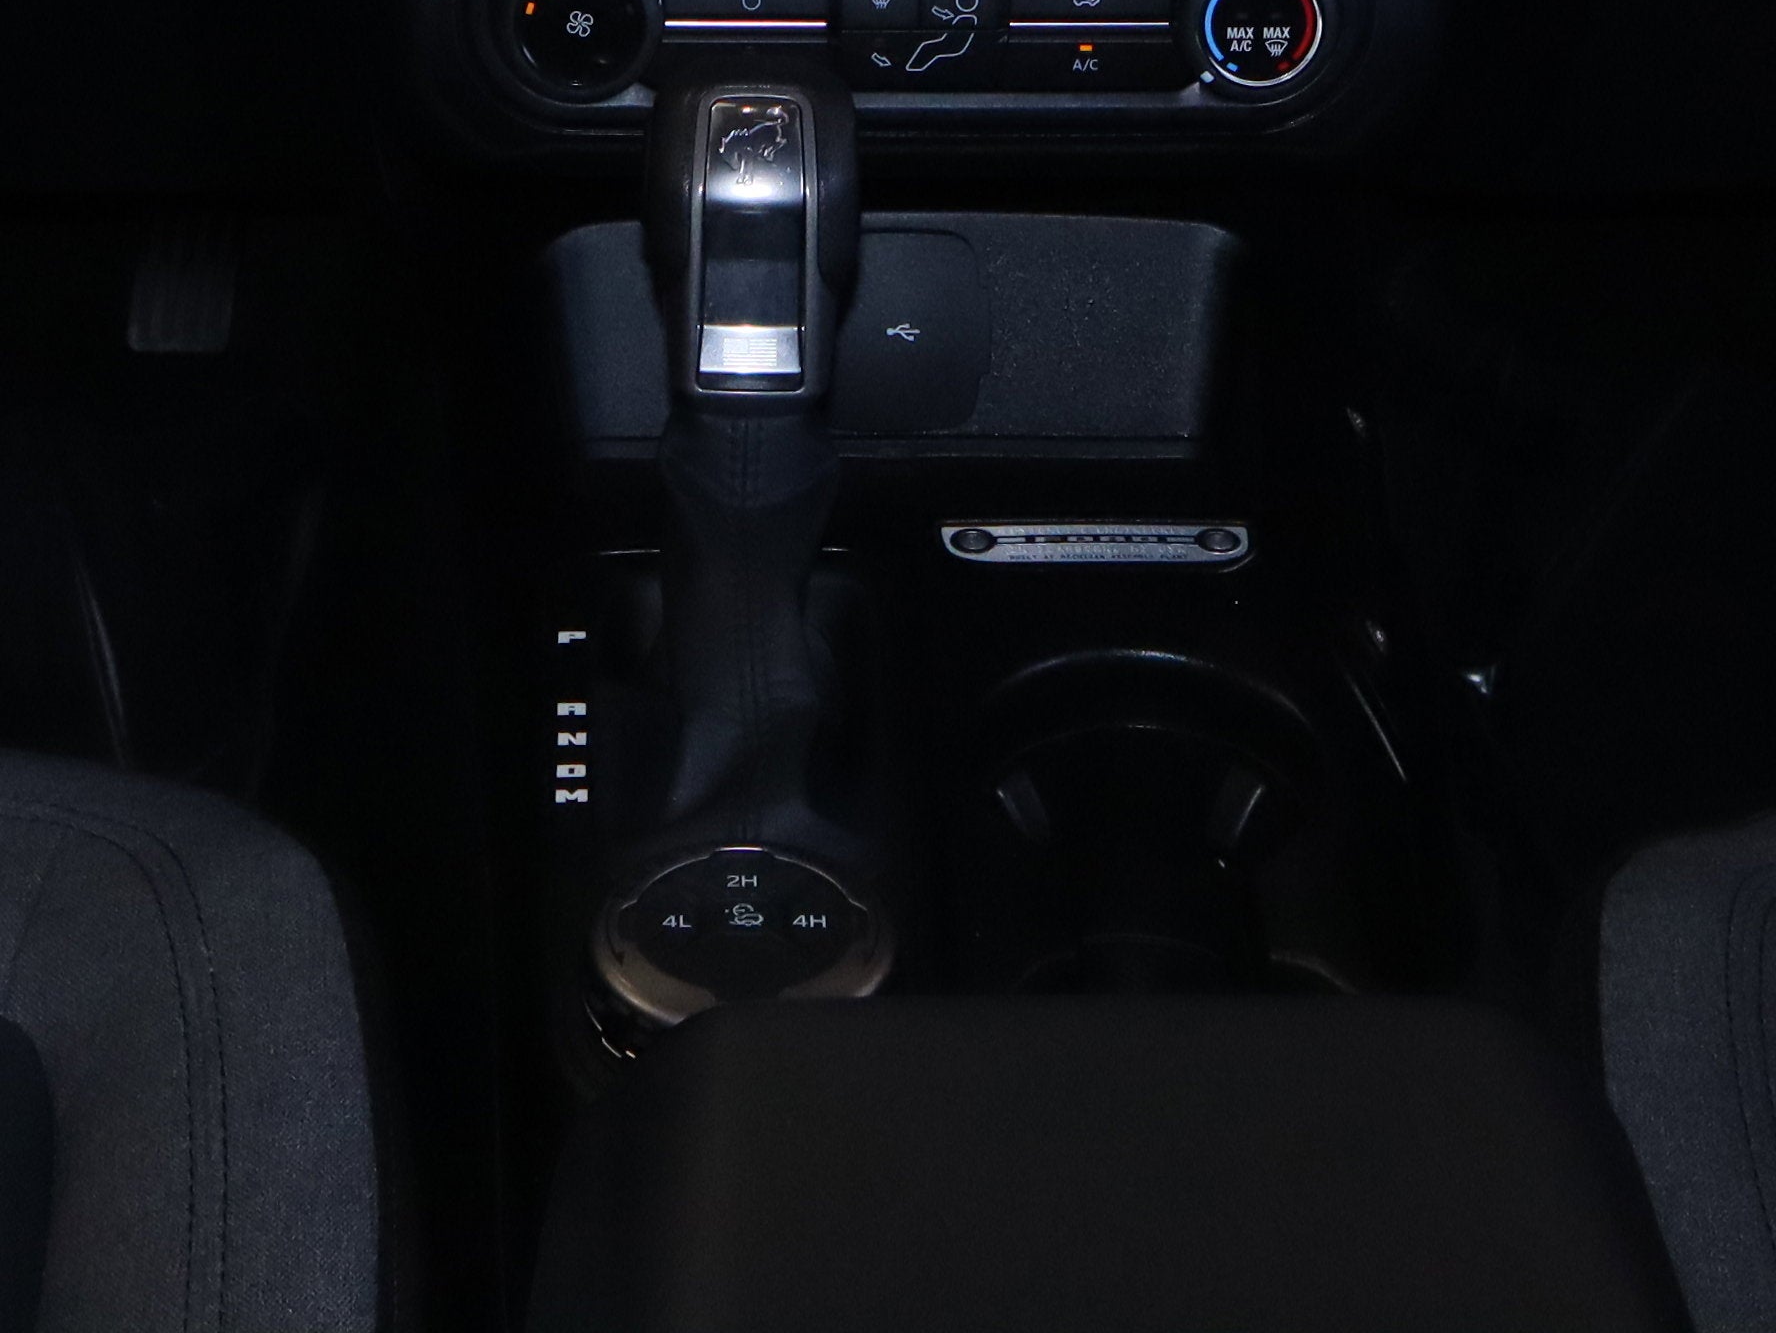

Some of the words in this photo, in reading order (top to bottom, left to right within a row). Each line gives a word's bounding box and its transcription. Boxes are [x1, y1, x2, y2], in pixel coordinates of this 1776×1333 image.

[1227, 27, 1254, 39] MAX
[1263, 27, 1290, 39] MAX
[1230, 39, 1253, 52] A/C
[1072, 56, 1099, 72] A/C
[557, 630, 587, 644] P
[557, 732, 587, 746] N
[555, 788, 588, 803] M
[726, 874, 757, 888] 2H
[662, 914, 692, 928] 4L
[792, 914, 827, 929] 4H
